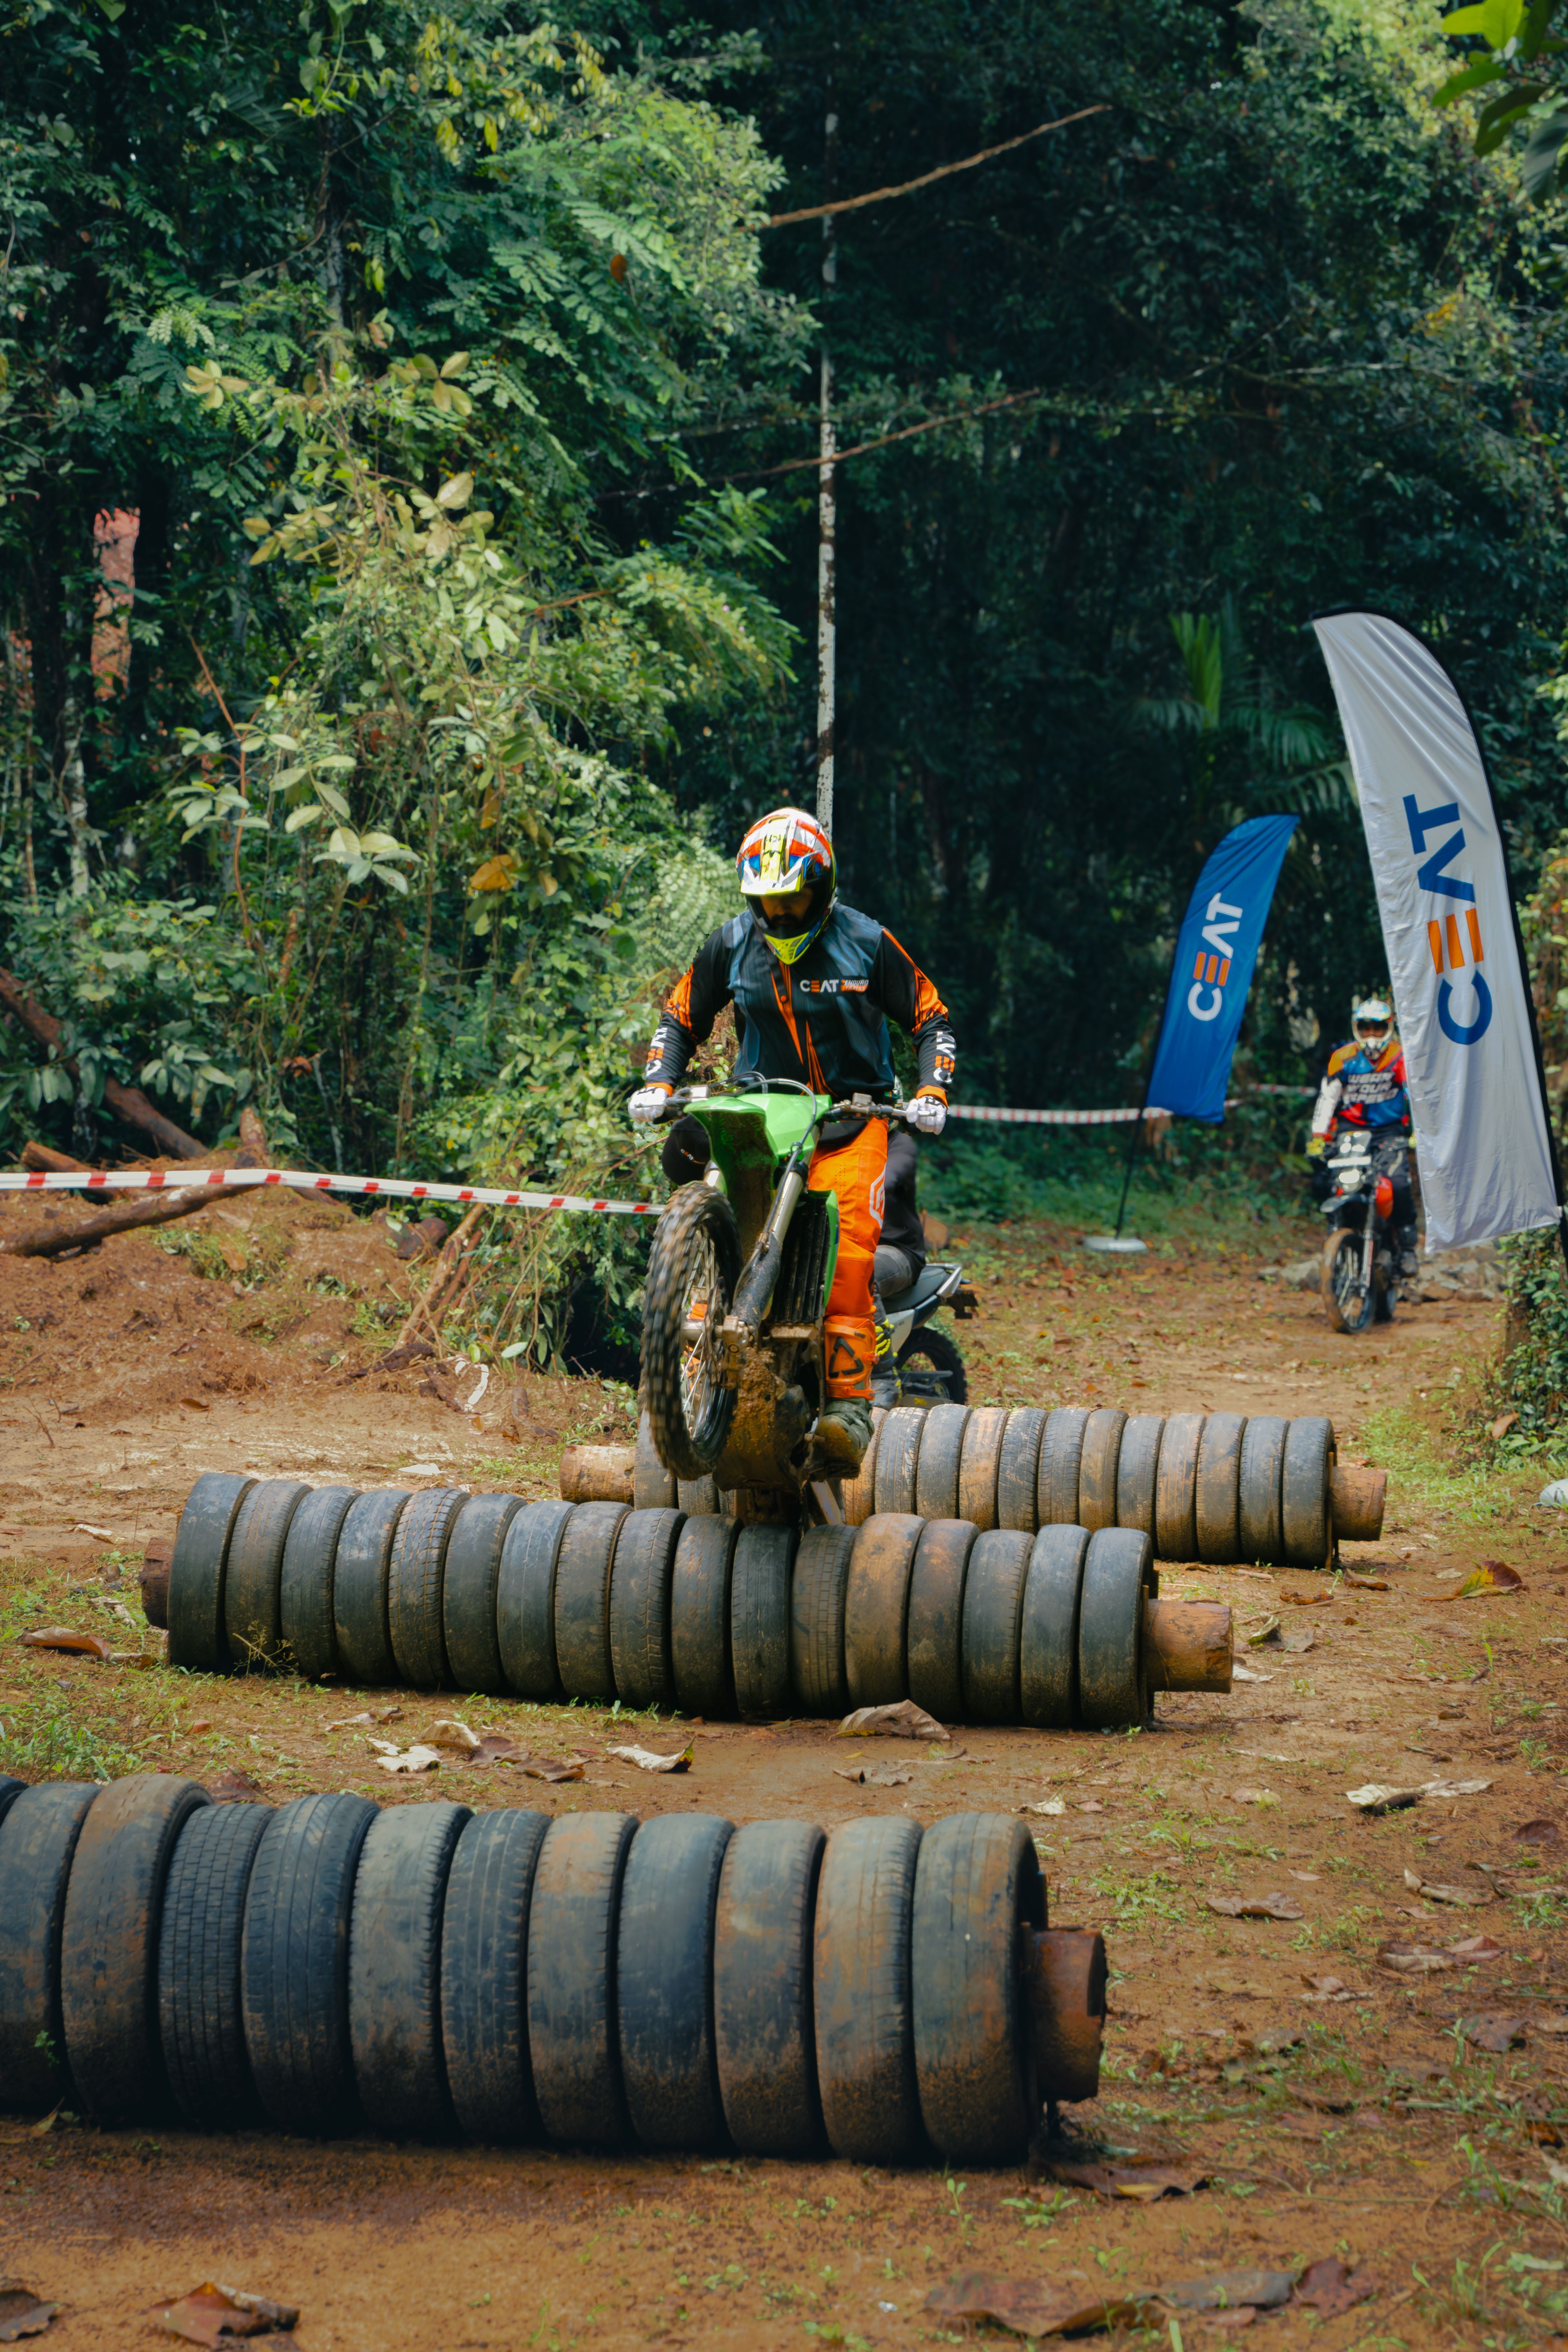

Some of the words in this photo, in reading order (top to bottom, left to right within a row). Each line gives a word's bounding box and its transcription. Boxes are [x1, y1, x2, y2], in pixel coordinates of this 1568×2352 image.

[1187, 892, 1243, 1022] CEAT
[1403, 793, 1492, 1045] CEAT
[799, 979, 839, 993] CEAT
[933, 1031, 955, 1084] CEAT
